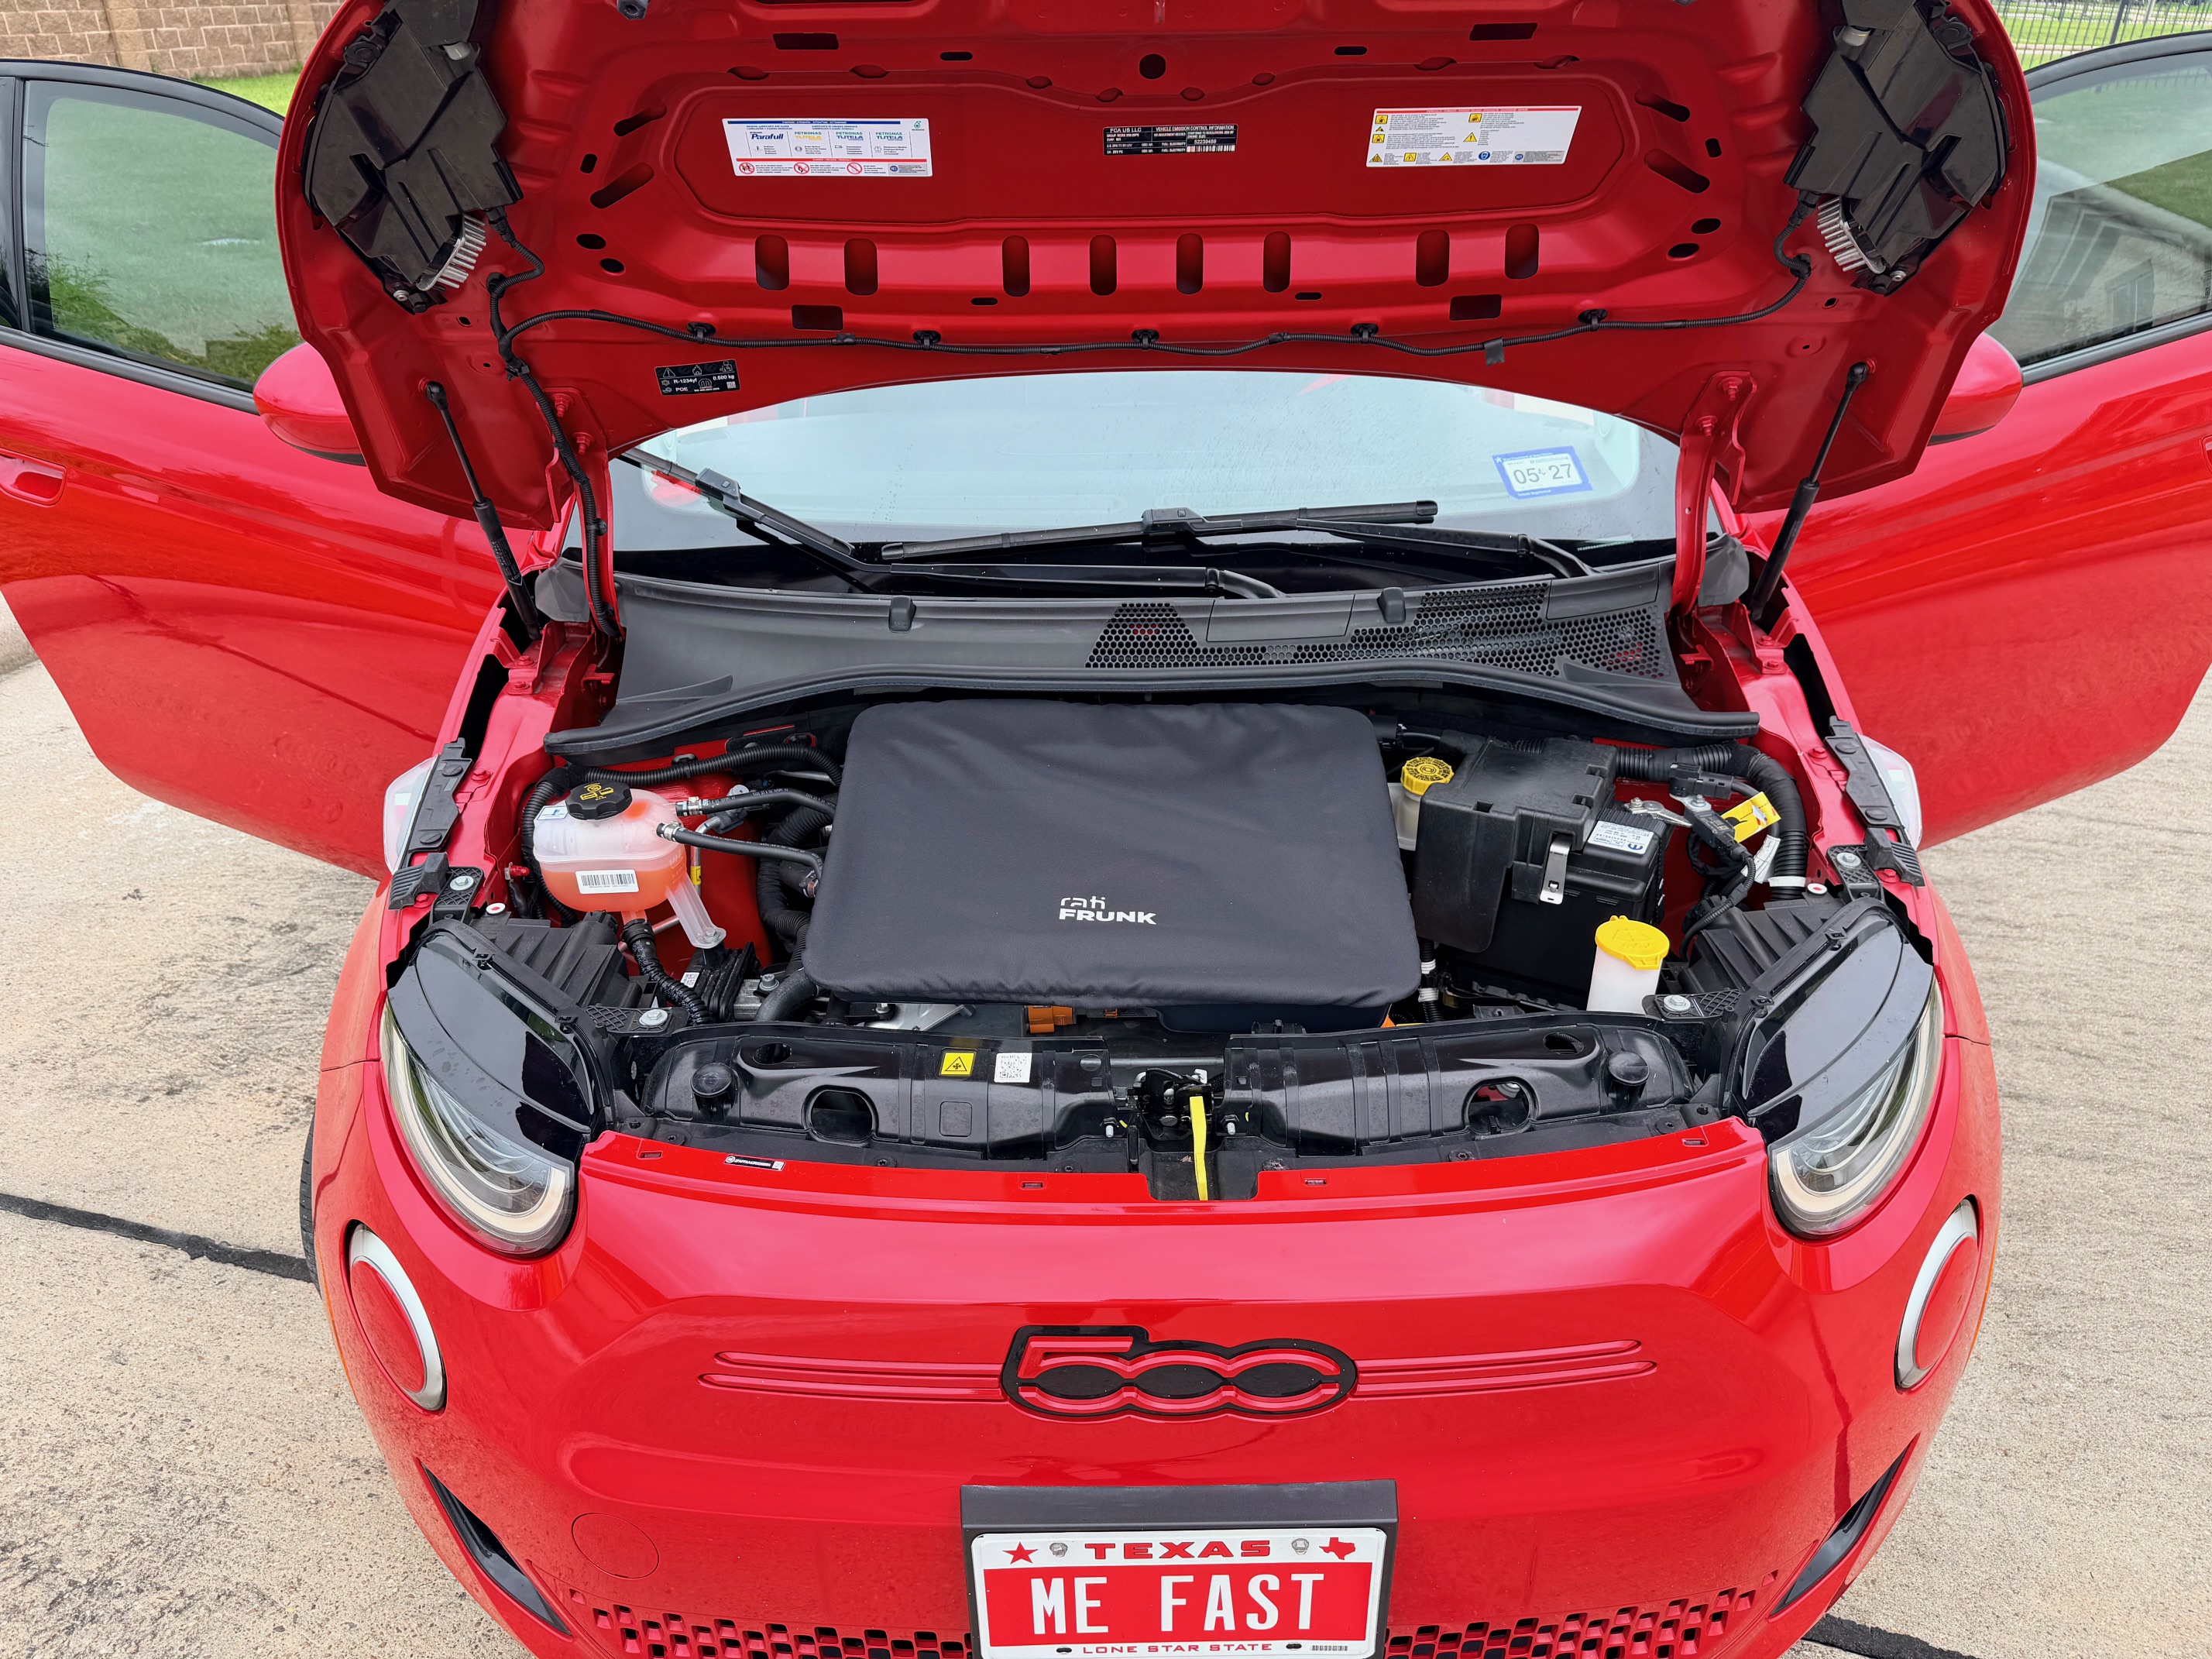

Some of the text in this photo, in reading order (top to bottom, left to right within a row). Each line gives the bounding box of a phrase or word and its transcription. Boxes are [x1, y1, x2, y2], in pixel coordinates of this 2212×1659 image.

[1513, 463, 1571, 484] 05 27
[1059, 908, 1157, 925] FRUNK
[1009, 1329, 1349, 1417] 500
[1084, 1540, 1270, 1560] TEXAS
[1030, 1573, 1324, 1634] ME FAST
[1083, 1643, 1273, 1654] LONE STAR STATE
